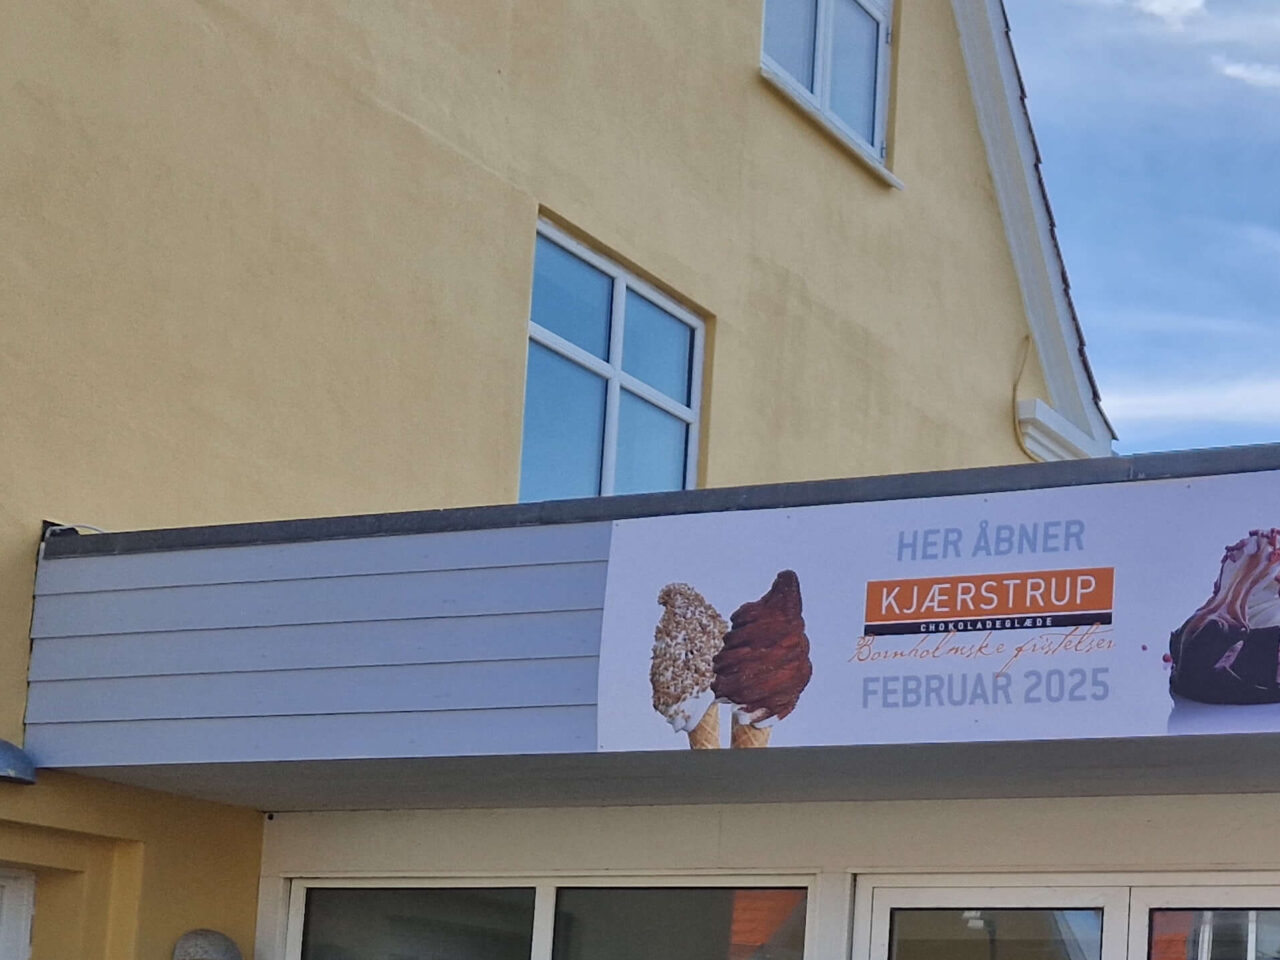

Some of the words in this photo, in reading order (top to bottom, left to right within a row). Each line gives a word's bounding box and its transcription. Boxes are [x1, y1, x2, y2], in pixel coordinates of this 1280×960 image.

[897, 526, 963, 562] HER
[971, 519, 1086, 558] ÅBNER
[880, 575, 1097, 615] KJÆRSTRUP
[920, 617, 1053, 632] CHOKOLADEGLÆDE
[861, 671, 1013, 709] FEBRUAR
[1024, 667, 1110, 704] 2025
